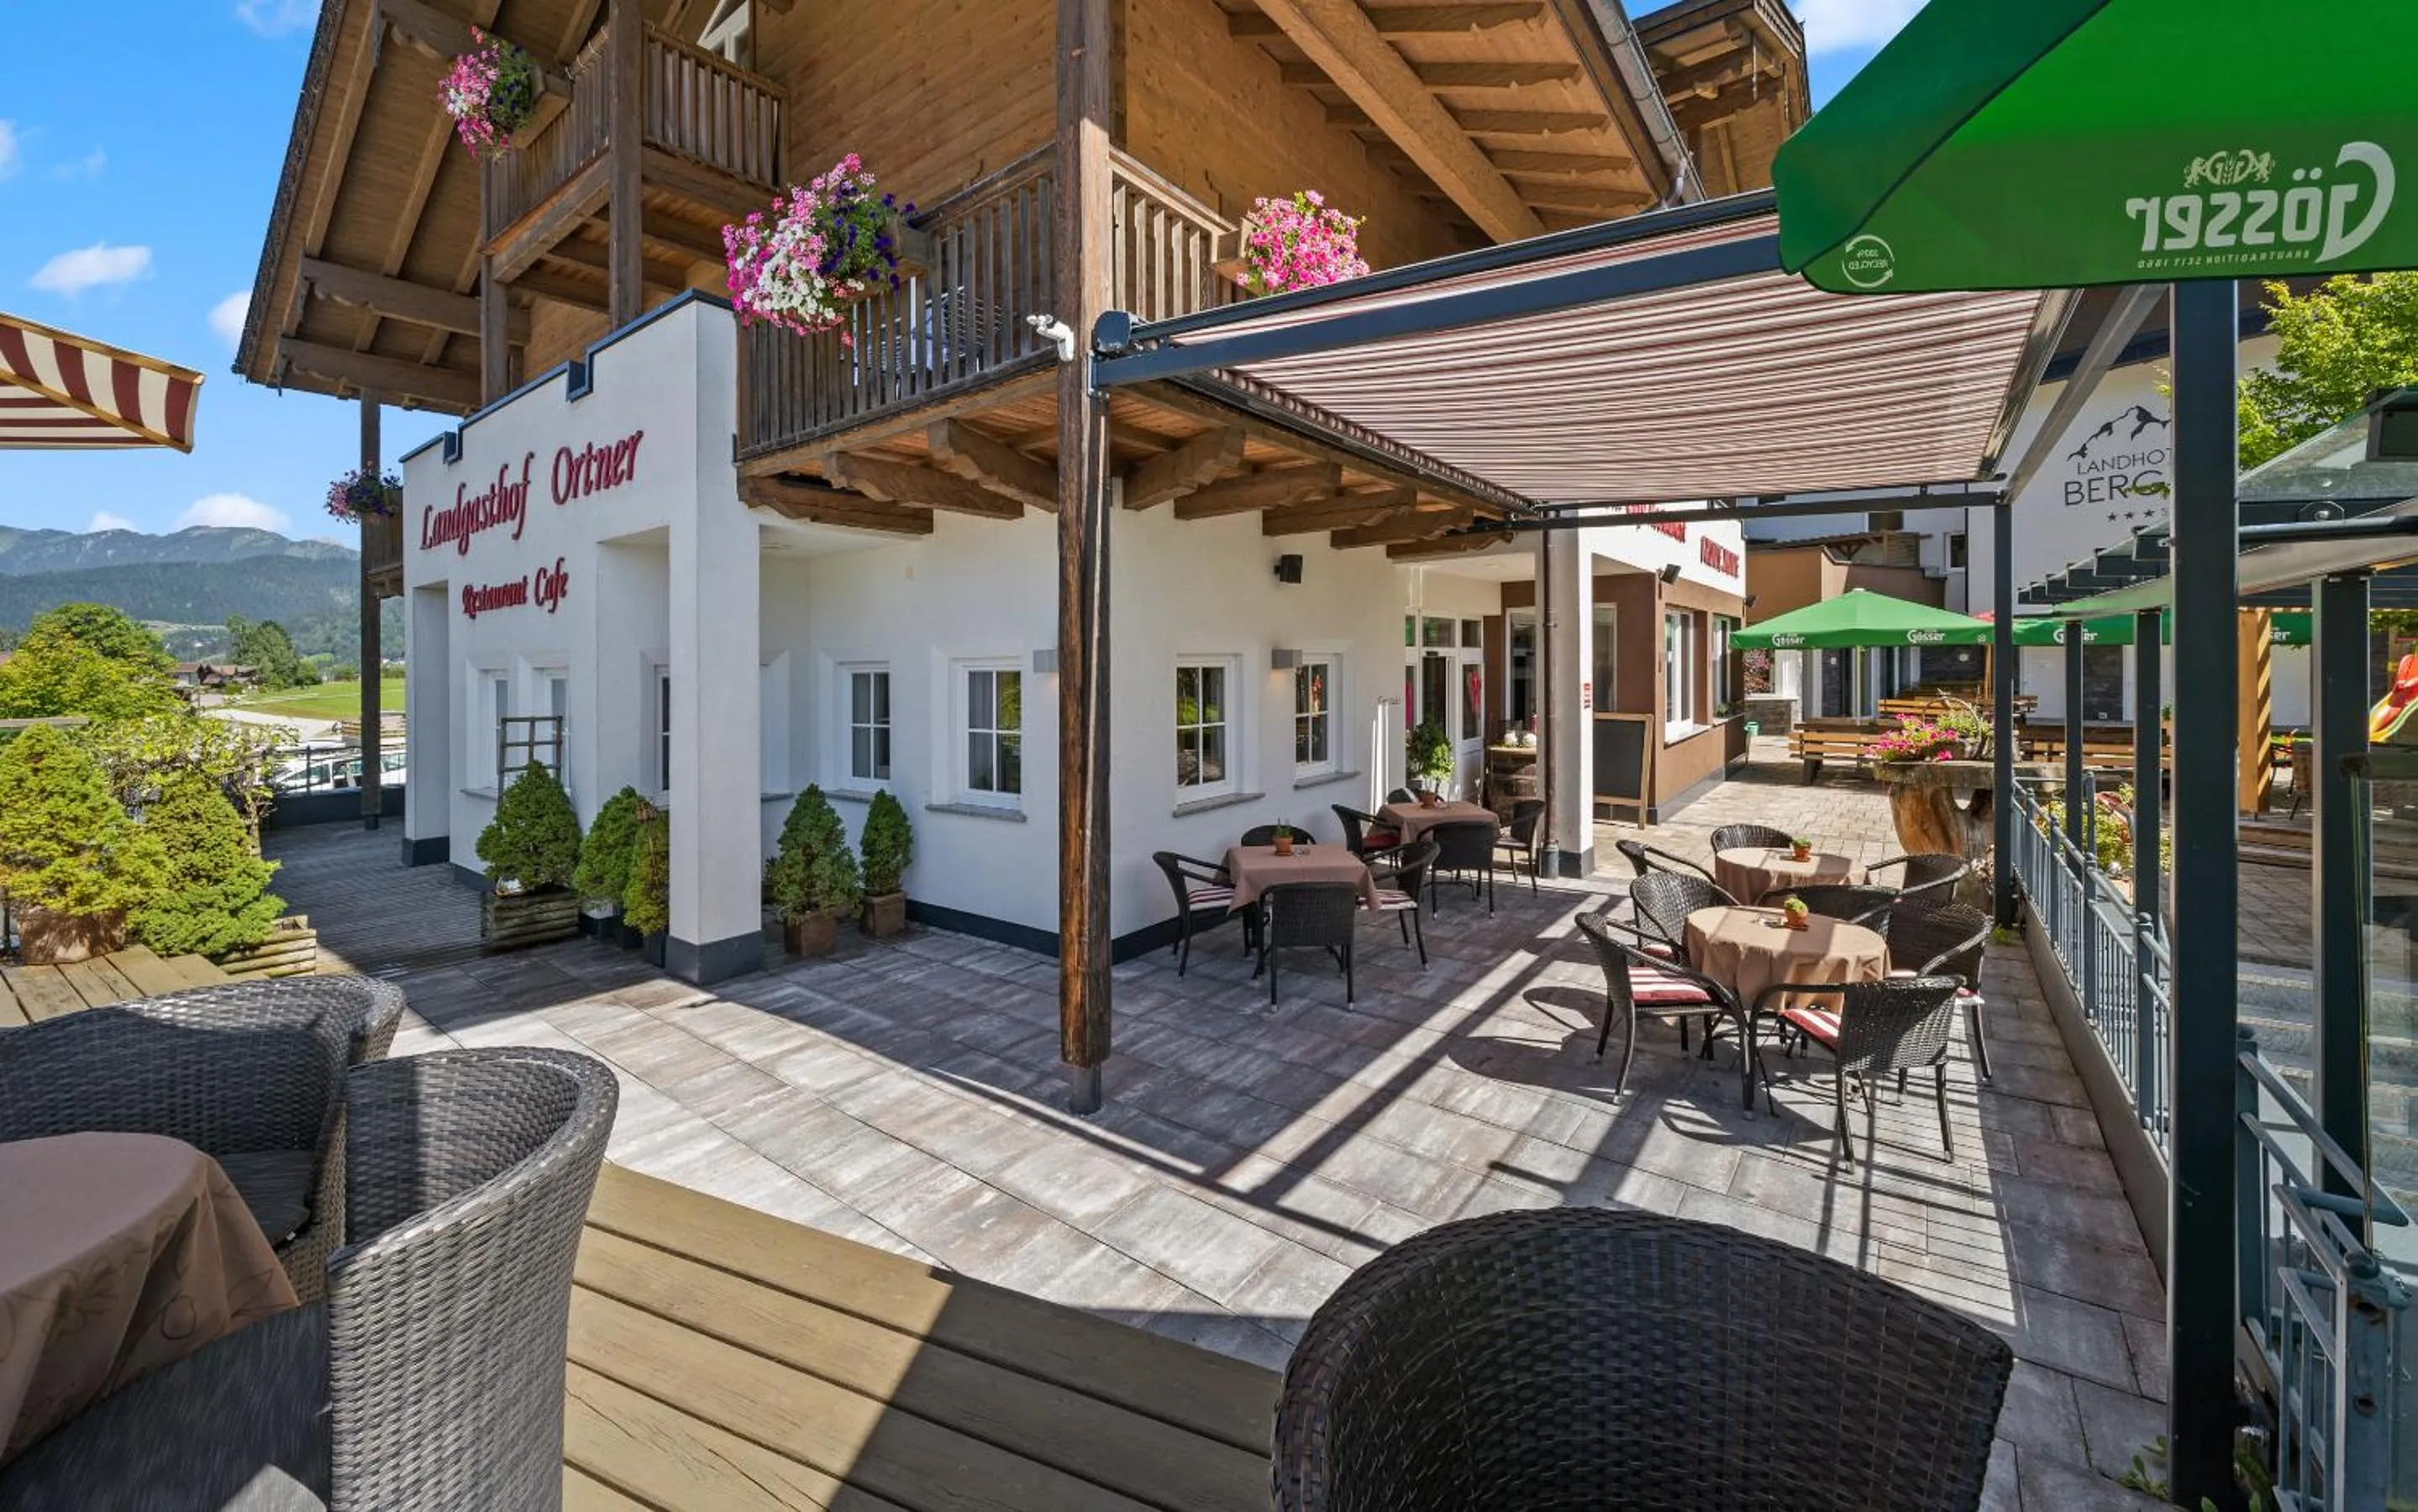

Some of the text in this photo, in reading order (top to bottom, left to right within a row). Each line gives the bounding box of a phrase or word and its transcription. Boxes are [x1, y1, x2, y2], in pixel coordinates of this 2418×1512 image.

[420, 430, 644, 555] Landgasthof Ortner
[2064, 470, 2171, 507] BERG
[462, 557, 569, 619] Restaurant Cafe
